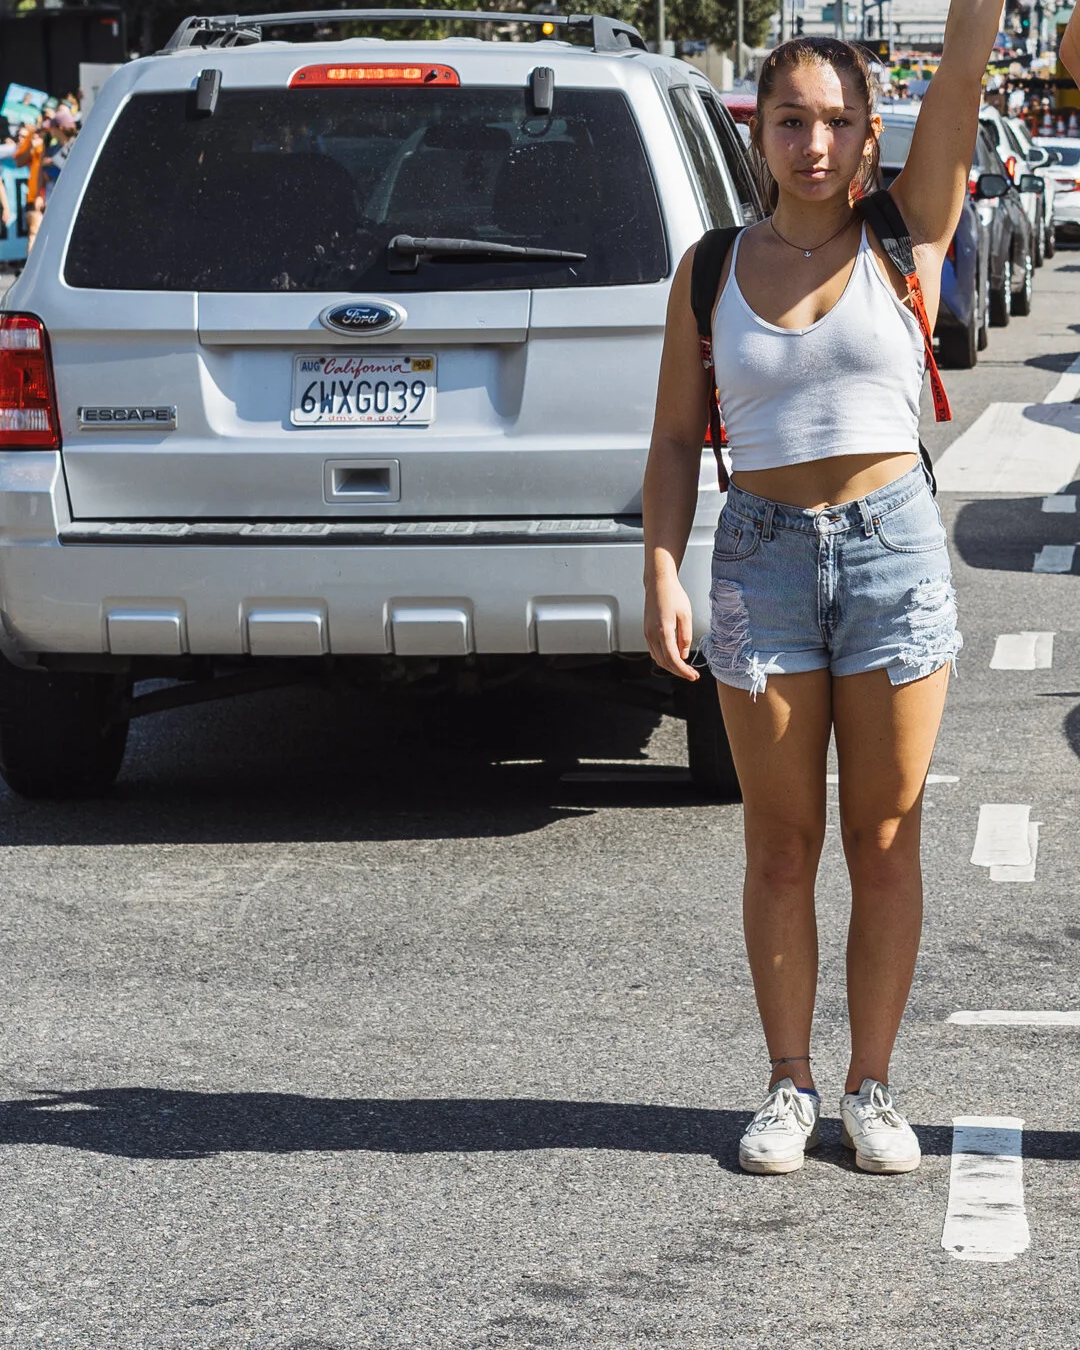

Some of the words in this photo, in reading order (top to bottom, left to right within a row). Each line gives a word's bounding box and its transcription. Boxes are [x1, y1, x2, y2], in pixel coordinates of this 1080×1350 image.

[342, 307, 380, 324] Ford
[301, 361, 321, 371] AUG
[323, 357, 412, 379] California
[300, 379, 427, 414] 6WXG039
[85, 409, 169, 421] ESCAPE
